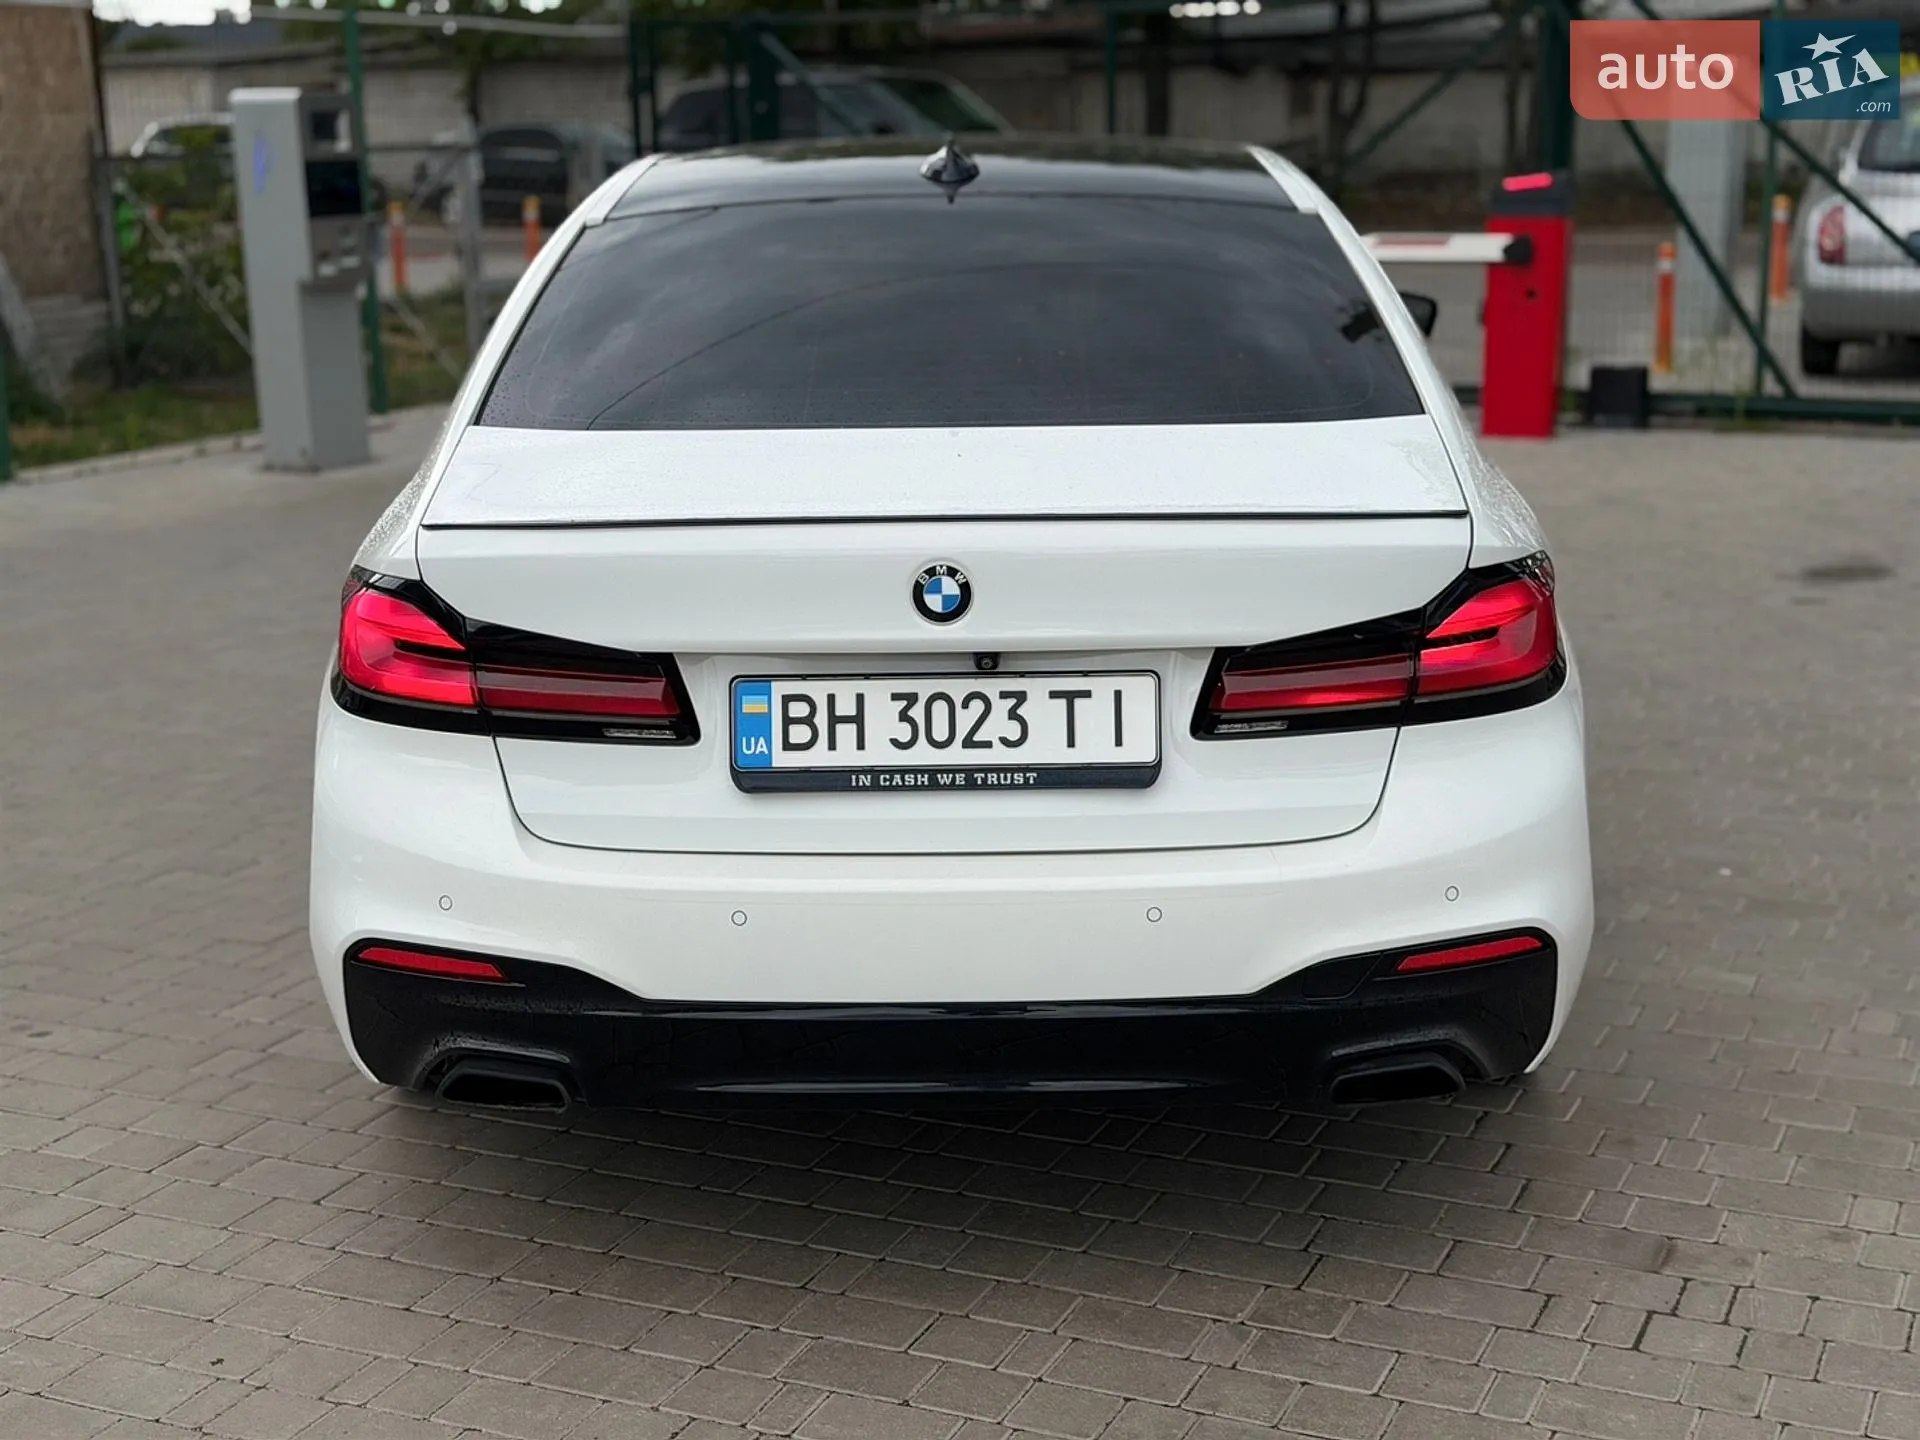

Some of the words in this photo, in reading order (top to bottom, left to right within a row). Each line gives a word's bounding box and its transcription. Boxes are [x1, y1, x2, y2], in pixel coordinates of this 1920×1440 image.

[917, 565, 967, 585] BMW
[781, 692, 865, 751] BH
[889, 690, 1029, 750] 3023
[1049, 689, 1122, 748] TI
[742, 737, 768, 754] UA
[851, 773, 872, 786] IN
[880, 773, 929, 786] CASH
[937, 772, 966, 785] WE
[973, 771, 1038, 785] TRUST
